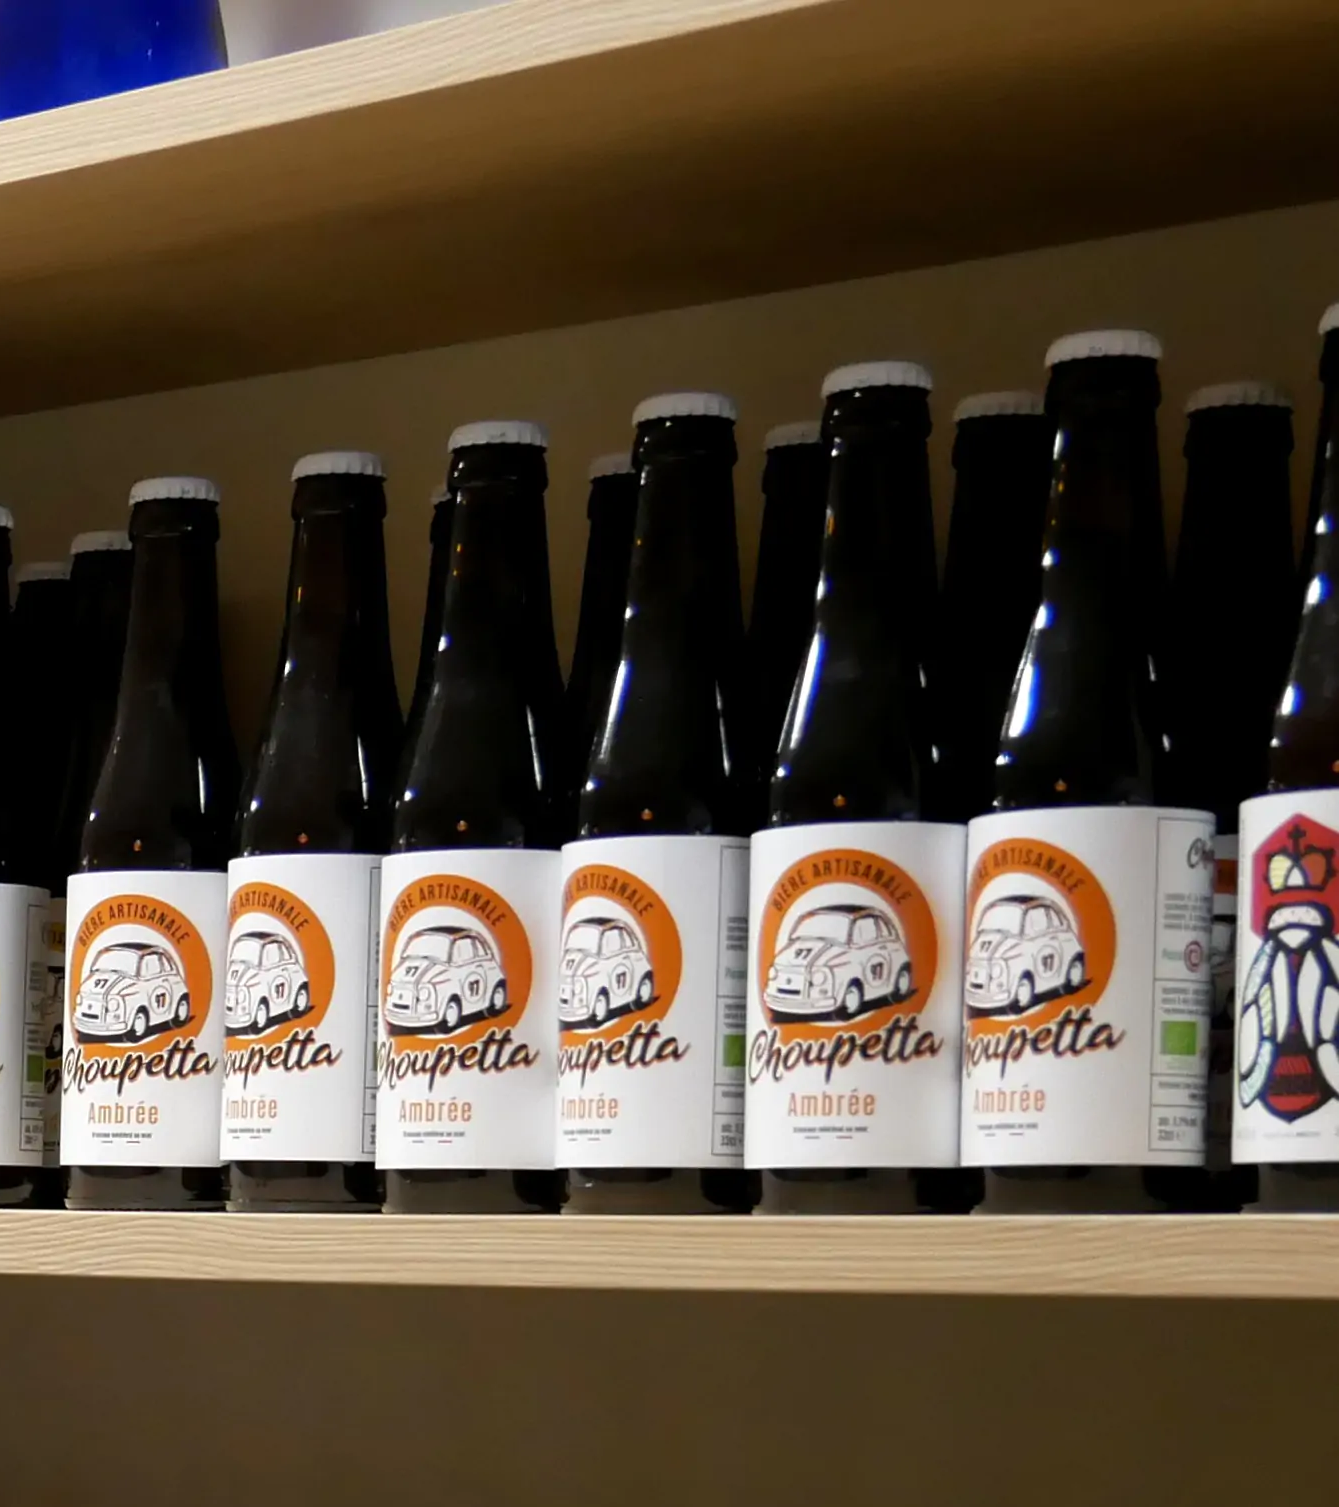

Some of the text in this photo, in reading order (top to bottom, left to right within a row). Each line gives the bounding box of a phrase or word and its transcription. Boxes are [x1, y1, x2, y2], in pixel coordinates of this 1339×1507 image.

[993, 848, 1085, 893] ARTISANALE
[575, 872, 654, 918] ARTISANALE
[772, 858, 912, 912] BIÈRE ARTISANALE
[238, 890, 310, 934] ARTISANALE
[418, 883, 508, 928] ARTISANALE
[108, 902, 191, 945] ARTISANALE
[794, 948, 812, 960] 97
[1041, 953, 1056, 972] 97
[93, 978, 108, 990] 97
[404, 965, 419, 978] 97
[154, 992, 167, 1008] 97
[467, 980, 480, 997] 97
[749, 1015, 943, 1085] Choupetta
[63, 1038, 218, 1096] Choupetta
[87, 1100, 158, 1124] Ambrée
[398, 1096, 472, 1123] Ambrée
[788, 1089, 876, 1117] Ambrée
